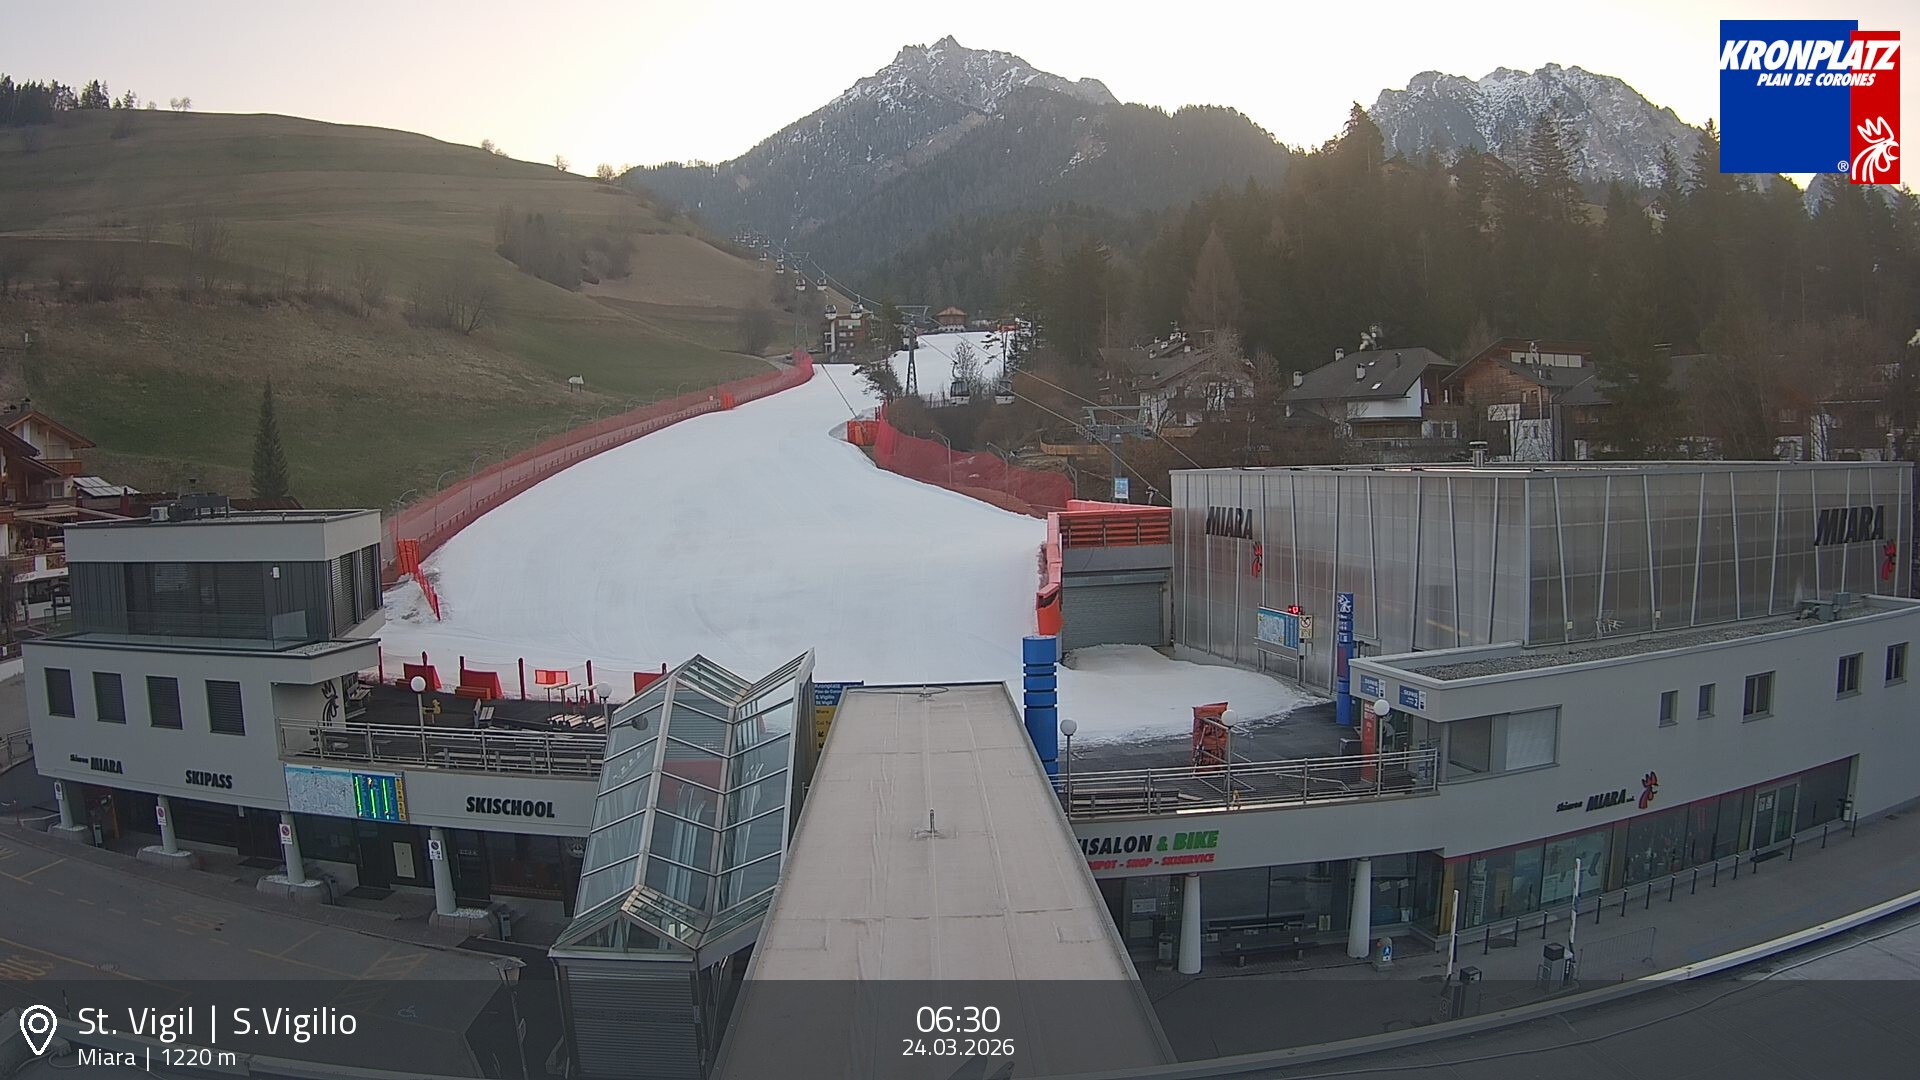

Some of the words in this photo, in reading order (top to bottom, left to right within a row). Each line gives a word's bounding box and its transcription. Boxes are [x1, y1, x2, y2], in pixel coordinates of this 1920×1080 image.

[1206, 506, 1253, 540] MIARA
[1814, 505, 1884, 546] MIARA
[91, 757, 123, 774] MIARA
[185, 770, 233, 789] SKIPASS
[466, 796, 555, 818] SKISCHOOL
[1586, 789, 1627, 812] MIARA
[1077, 835, 1153, 855] ISALON
[1156, 836, 1168, 851] &
[1173, 830, 1219, 850] BIKE
[1126, 858, 1153, 868] SHOP
